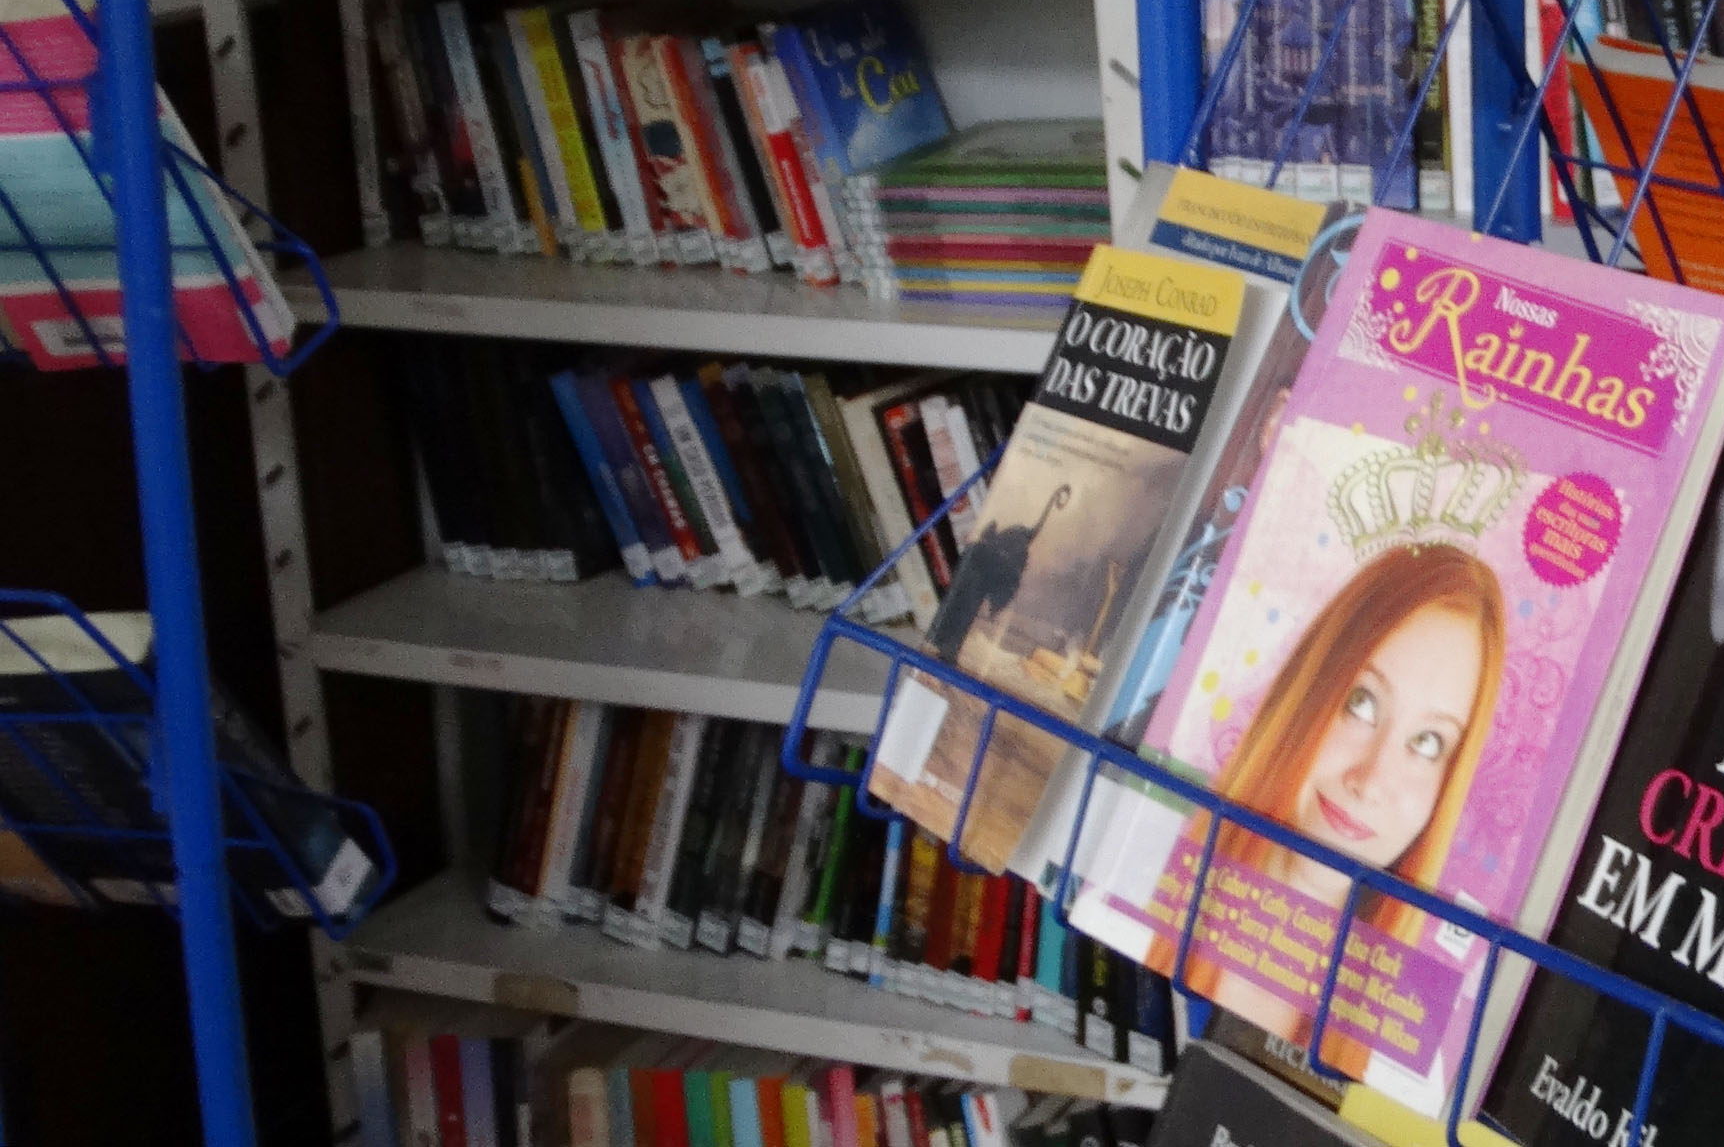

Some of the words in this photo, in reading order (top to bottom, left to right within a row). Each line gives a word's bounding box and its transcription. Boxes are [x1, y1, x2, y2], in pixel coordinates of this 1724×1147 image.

[1065, 311, 1091, 347] O
[1090, 316, 1217, 382] CORAÇÃO
[1388, 268, 1656, 430] Rainhas
[1493, 286, 1558, 330] Nossas
[1045, 356, 1101, 403] DAS
[1099, 368, 1198, 434] TREVAS
[1577, 834, 1687, 950] EM
[1529, 1054, 1609, 1142] Evaldo
